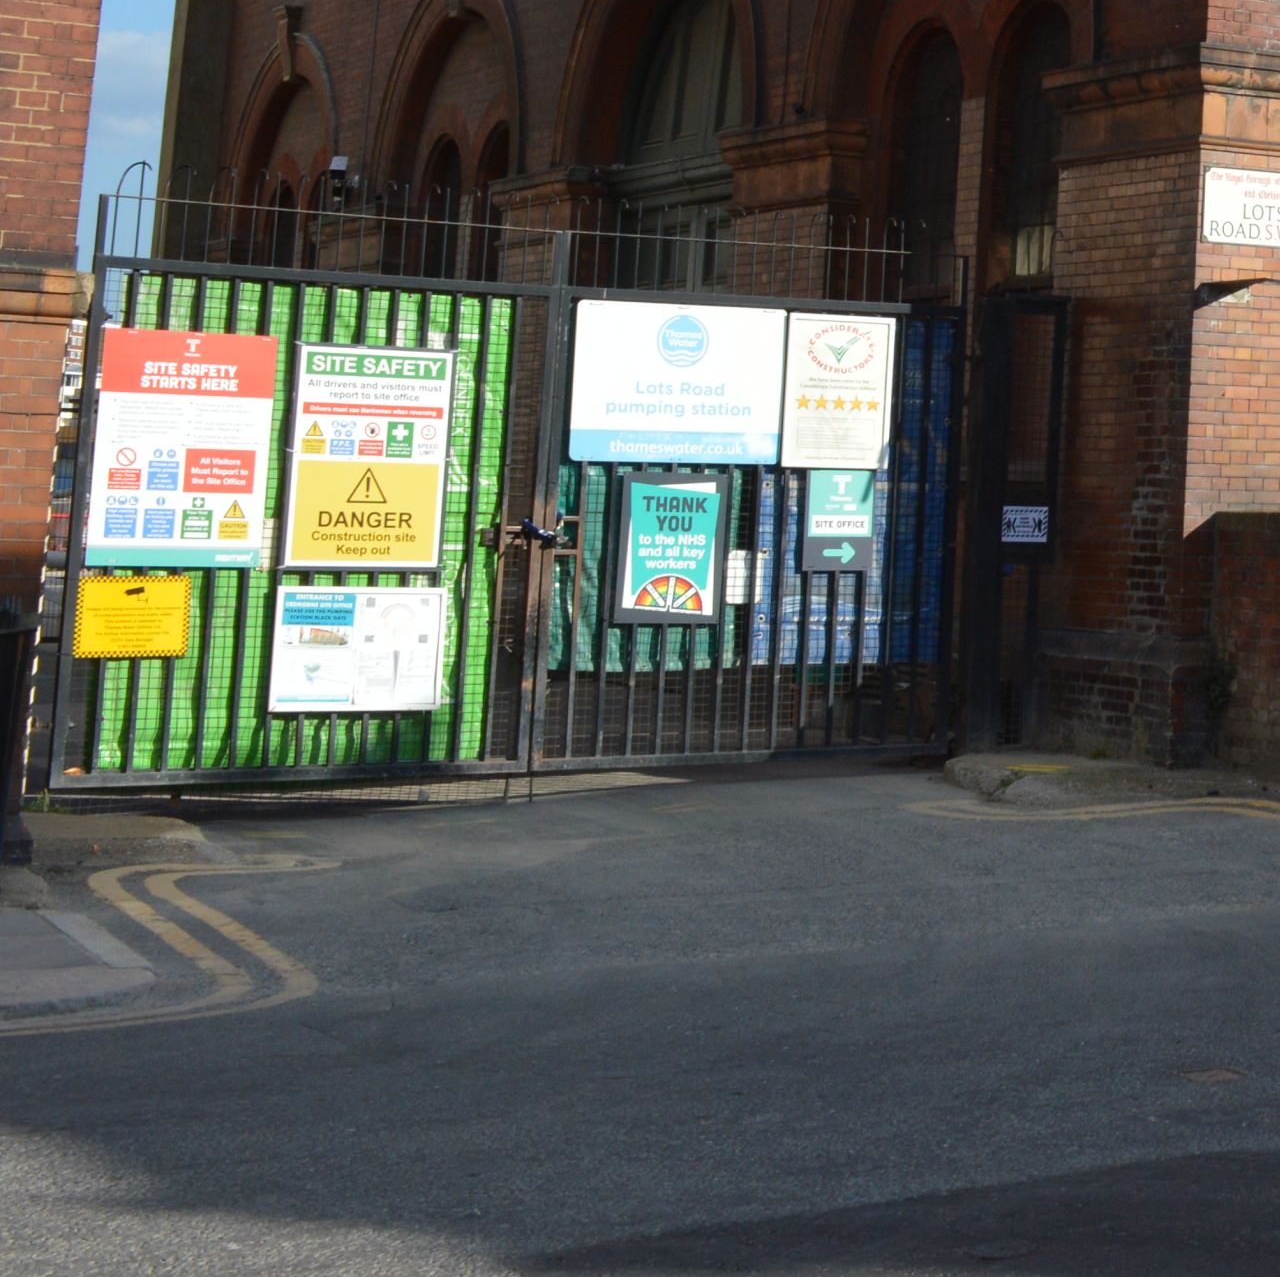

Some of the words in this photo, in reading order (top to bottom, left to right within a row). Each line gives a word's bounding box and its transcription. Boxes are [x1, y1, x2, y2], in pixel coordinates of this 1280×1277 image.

[1210, 171, 1224, 181] The
[1225, 173, 1244, 185] Royal
[1247, 174, 1271, 187] Borough
[1275, 177, 1280, 185] of
[1244, 190, 1256, 198] and
[665, 329, 703, 340] Thames
[668, 338, 698, 348] Water
[144, 361, 177, 375] SITE
[181, 363, 238, 377] SAFETY
[312, 355, 358, 373] SITE
[363, 357, 442, 377] SAFETY
[807, 350, 874, 374] CONSTRUCTORS
[140, 375, 197, 390] STARTS
[201, 378, 239, 392] HERE
[308, 379, 321, 387] All
[324, 380, 357, 389] drivers
[360, 381, 378, 390] and
[381, 383, 416, 392] visitors
[419, 385, 442, 393] must
[635, 381, 674, 395] Lots
[680, 382, 726, 397] Road
[329, 391, 359, 401] report
[362, 392, 371, 400] to
[374, 392, 391, 401] site
[394, 393, 420, 402] office
[605, 401, 685, 418] pumping
[691, 402, 752, 417] station
[609, 439, 743, 456] thameswater.co.uk
[200, 457, 210, 465] All
[212, 457, 241, 466] Visitors
[191, 467, 210, 475] Must
[212, 468, 238, 477] Report
[191, 477, 204, 485] the
[206, 477, 221, 485] Site
[223, 478, 246, 487] Office
[642, 495, 708, 513] THANK
[318, 510, 412, 528] DANGER
[656, 515, 693, 532] YOU
[815, 520, 833, 528] SITE
[836, 520, 865, 528] OFFICE
[311, 530, 391, 542] Construction
[395, 531, 416, 542] site
[638, 534, 652, 545] to
[655, 534, 675, 545] the
[678, 535, 706, 546] NHS
[336, 544, 367, 556] Keep
[371, 545, 391, 555] out
[638, 546, 662, 557] and
[665, 546, 679, 557] all
[683, 547, 705, 560] key
[645, 558, 697, 570] workers
